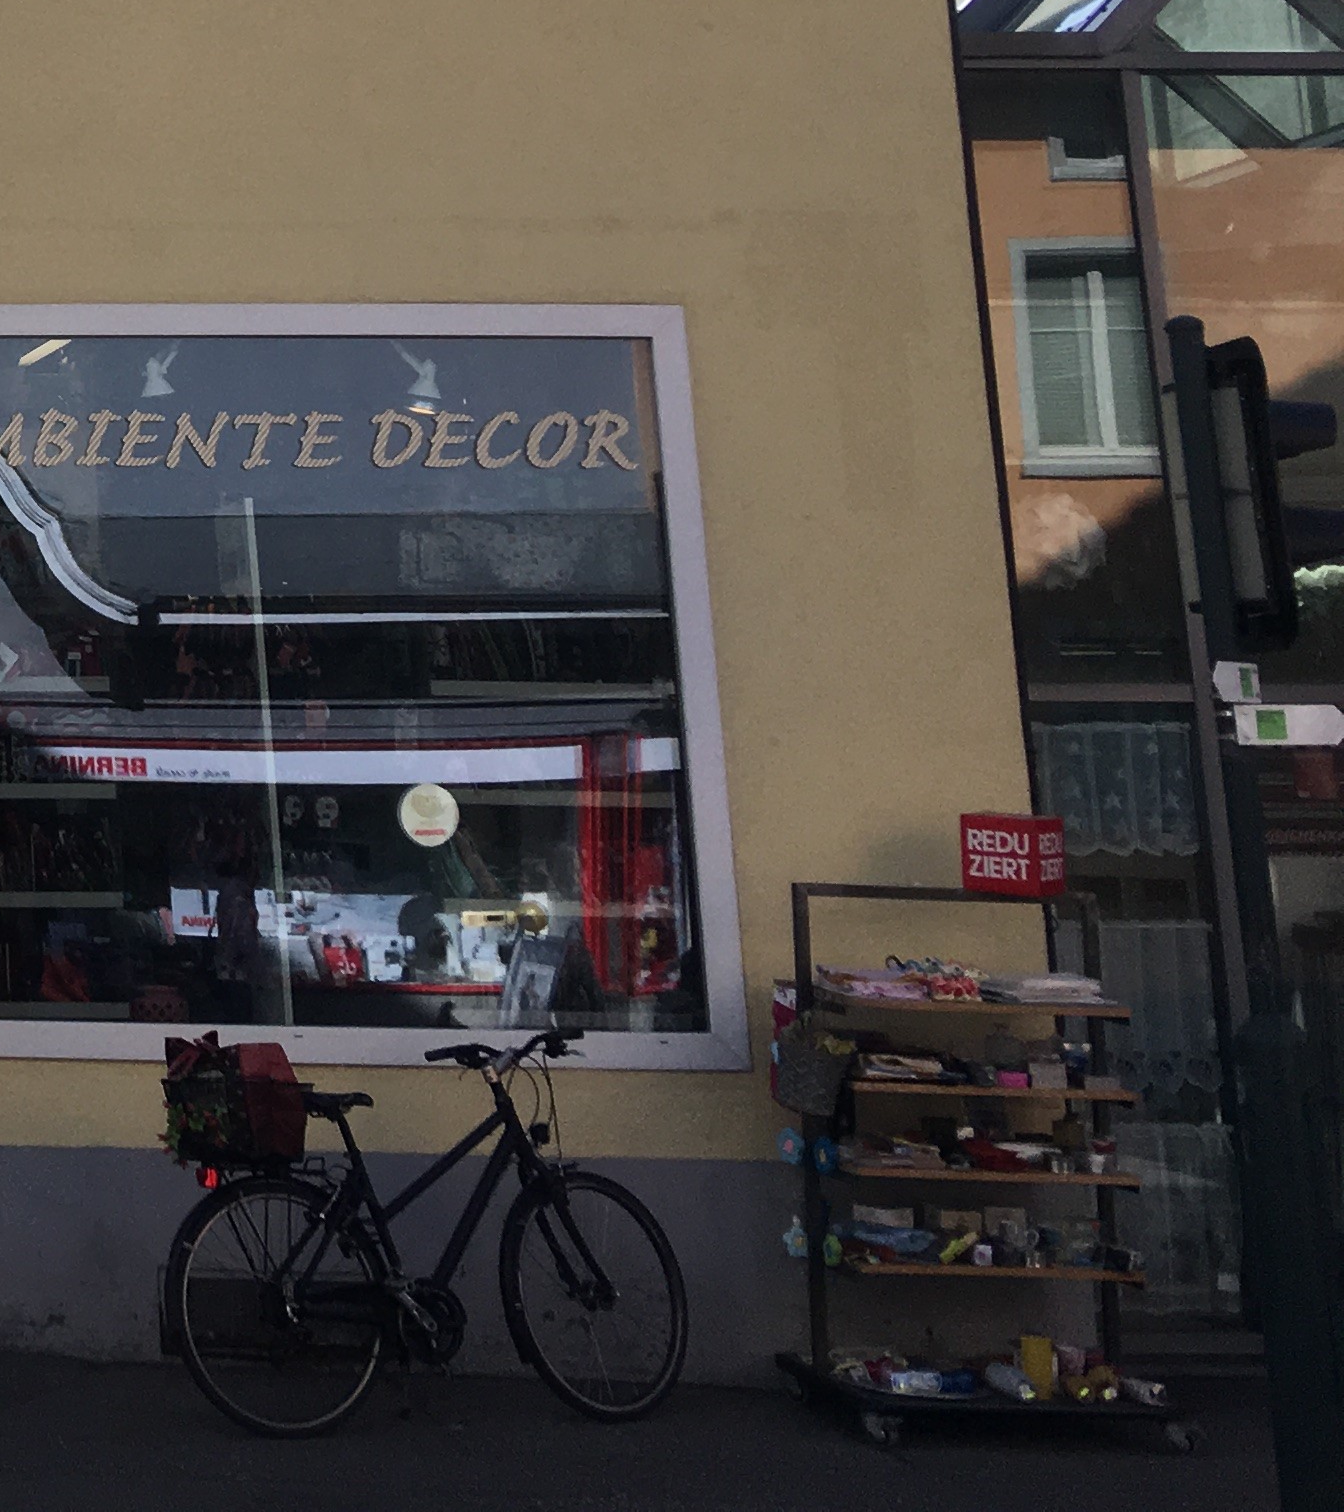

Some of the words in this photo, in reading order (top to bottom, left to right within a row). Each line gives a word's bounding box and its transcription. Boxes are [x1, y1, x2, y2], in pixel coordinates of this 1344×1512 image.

[370, 408, 640, 471] DECOR
[966, 828, 1030, 855] REDU
[969, 854, 1030, 881] ZIERT
